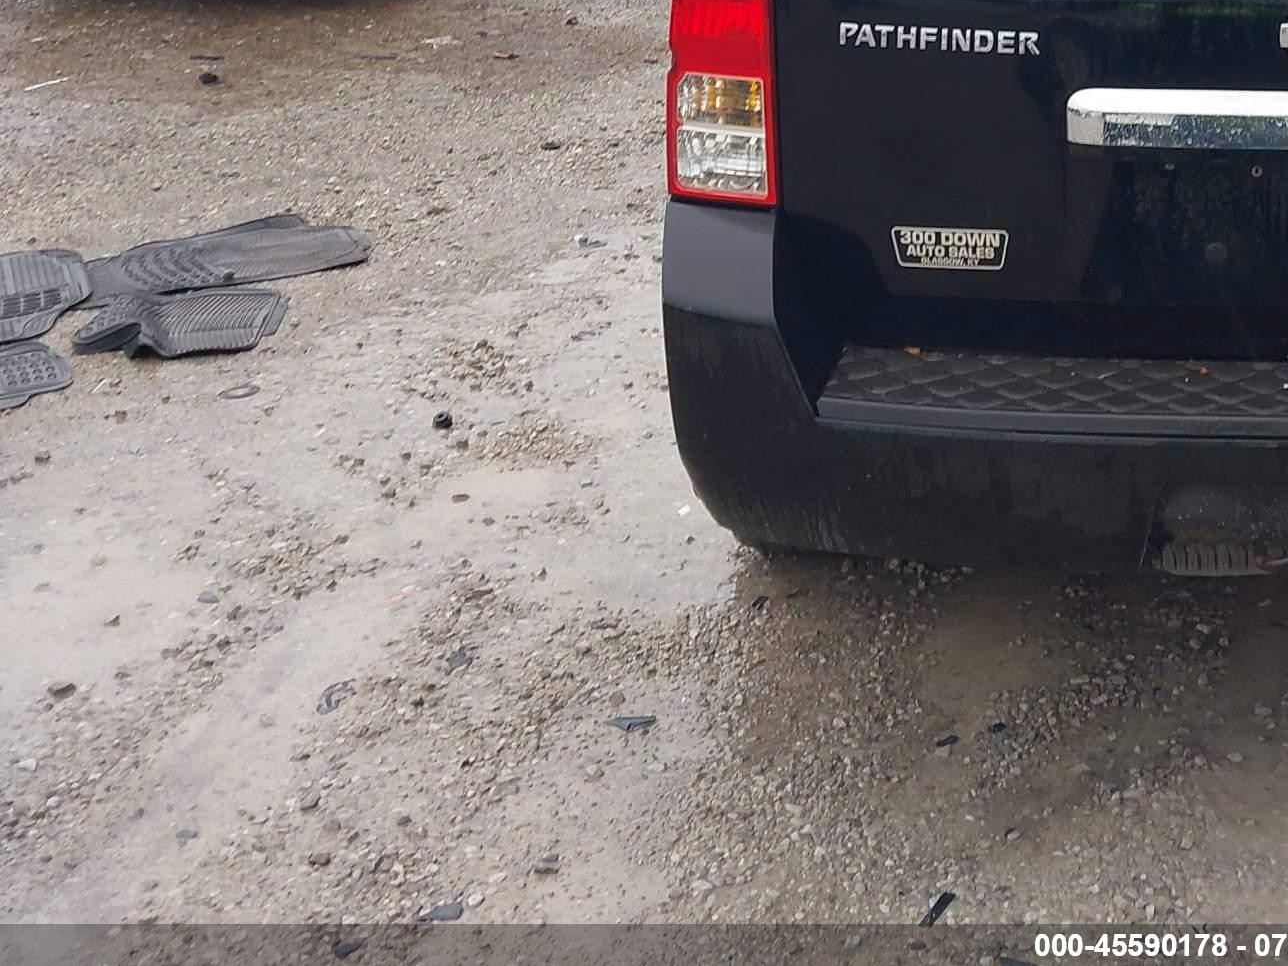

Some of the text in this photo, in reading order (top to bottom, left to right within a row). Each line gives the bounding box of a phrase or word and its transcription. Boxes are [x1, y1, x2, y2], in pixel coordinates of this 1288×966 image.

[839, 22, 1040, 55] PATHFINDER
[900, 231, 1000, 247] 300 DOWN
[906, 244, 995, 259] AUTO SALES
